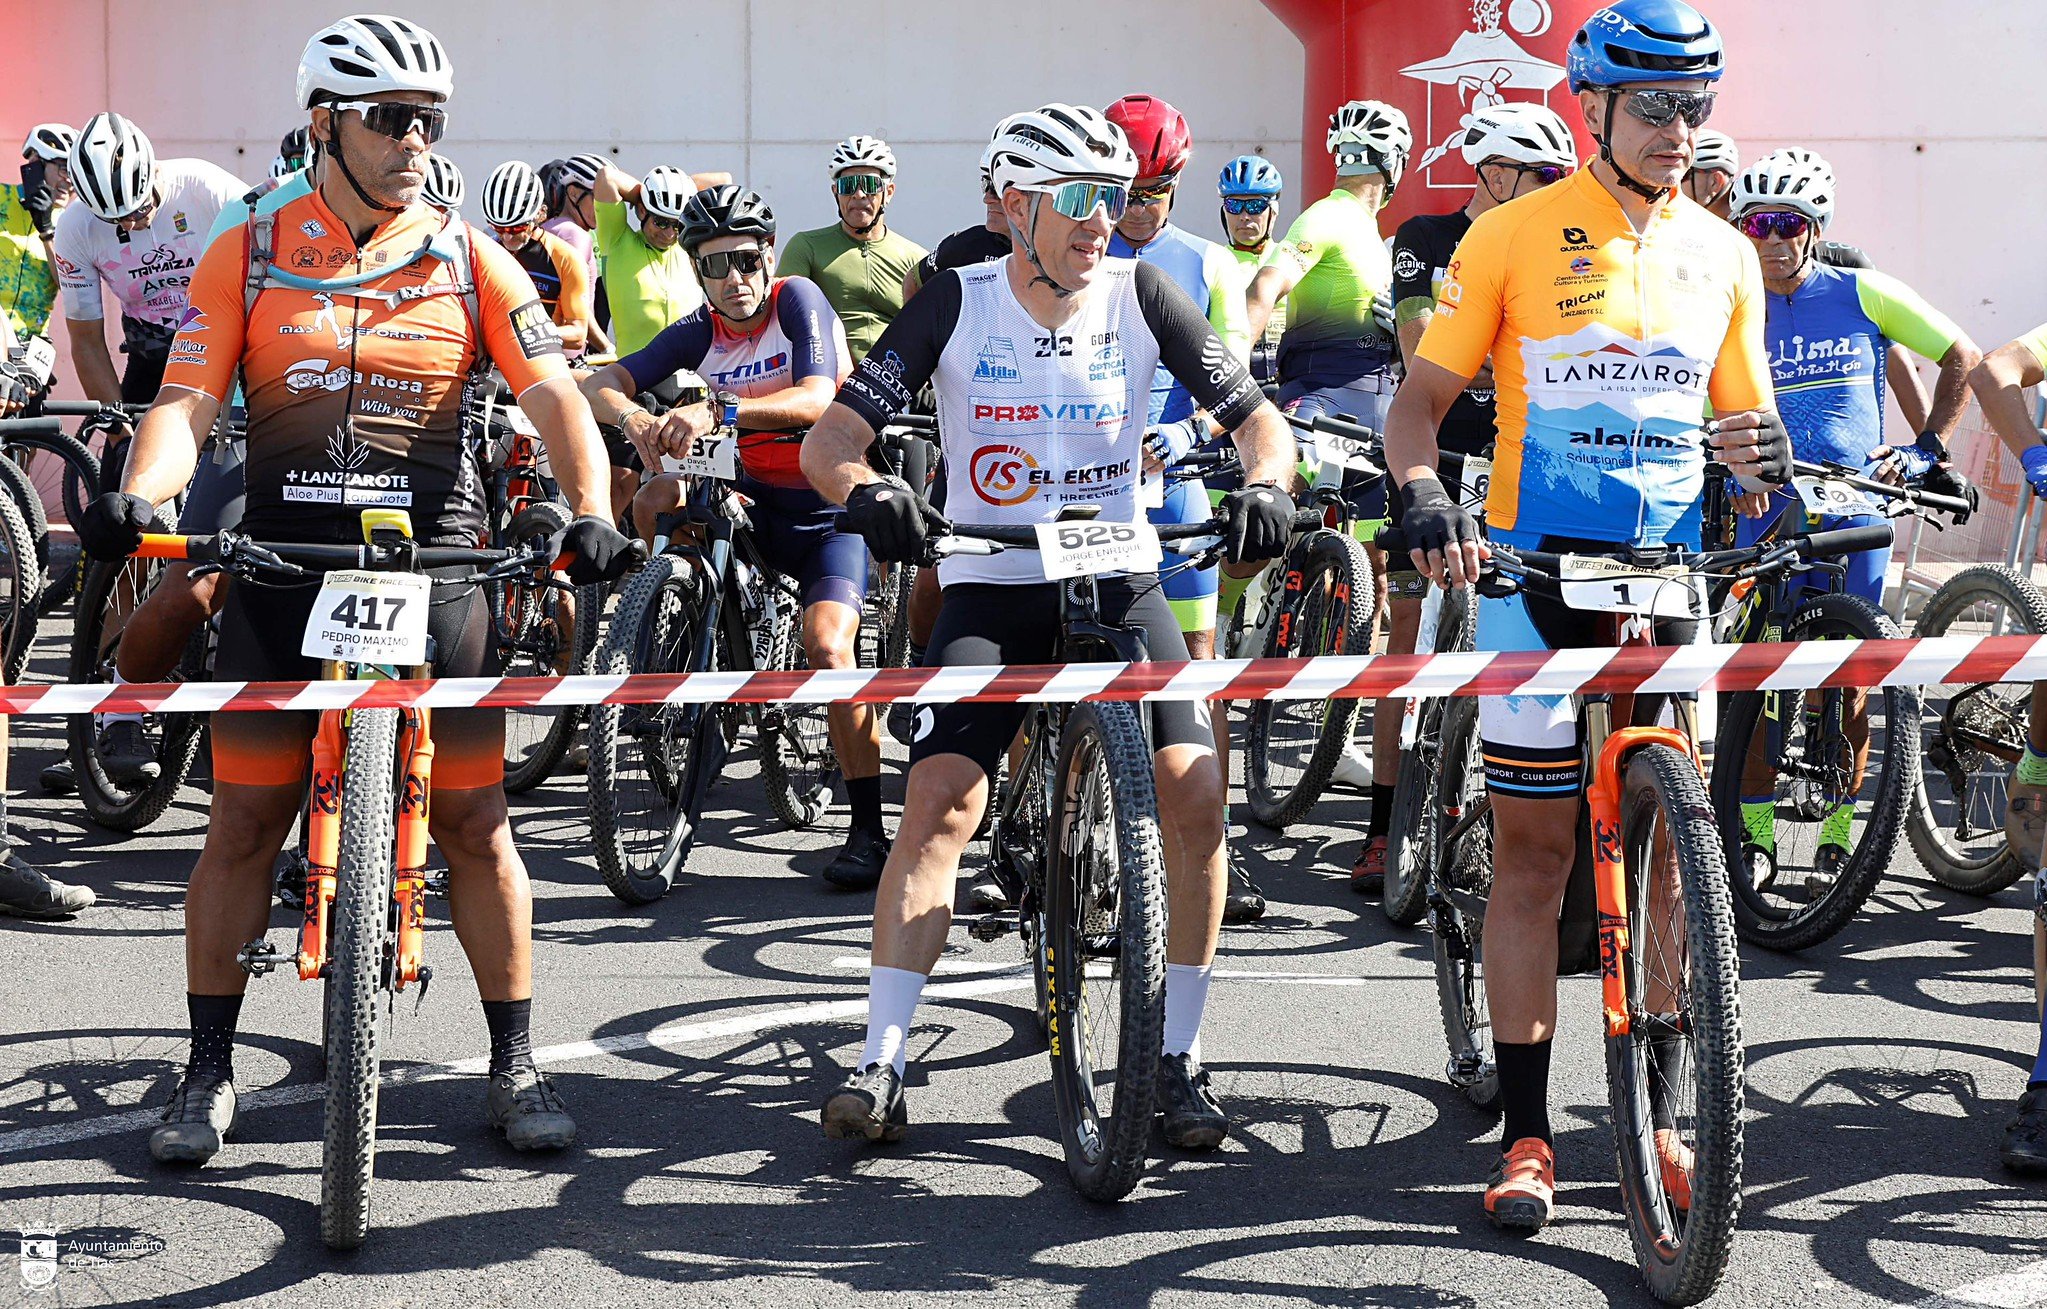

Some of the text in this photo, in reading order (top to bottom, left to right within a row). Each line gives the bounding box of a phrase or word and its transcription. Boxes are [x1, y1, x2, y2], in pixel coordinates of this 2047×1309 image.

[1593, 9, 1638, 33] UDY
[1477, 118, 1501, 129] MAVIC
[128, 257, 195, 280] TRIYAIZA
[143, 275, 190, 295] Area
[147, 293, 187, 307] ARABELL
[1556, 290, 1606, 311] TRICAN
[1561, 308, 1594, 319] LANZAROTE
[297, 369, 424, 394] Santa Rosa
[1545, 363, 1708, 390] LANZAROT
[1616, 385, 1637, 393] ISLA
[361, 398, 418, 419] With you
[1327, 436, 1358, 454] 40
[687, 457, 707, 466] David
[1566, 452, 1632, 467] Soluciones
[301, 470, 409, 488] LANZAROTE
[286, 487, 314, 500] Aloe
[316, 488, 339, 501] Plus
[1058, 525, 1136, 550] 525
[1059, 542, 1144, 563] JORGE ENRIQUE
[1604, 563, 1628, 572] BIKE
[353, 575, 377, 585] BIKE
[378, 578, 403, 586] RACE
[1613, 583, 1638, 607] 1
[330, 594, 407, 631] 417
[1787, 607, 1824, 634] AXXIS
[321, 630, 409, 647] PEDRO MAXIMO
[1521, 772, 1544, 781] CLUB
[1599, 929, 1619, 980] FOX
[1046, 946, 1060, 1056] MAXXIS
